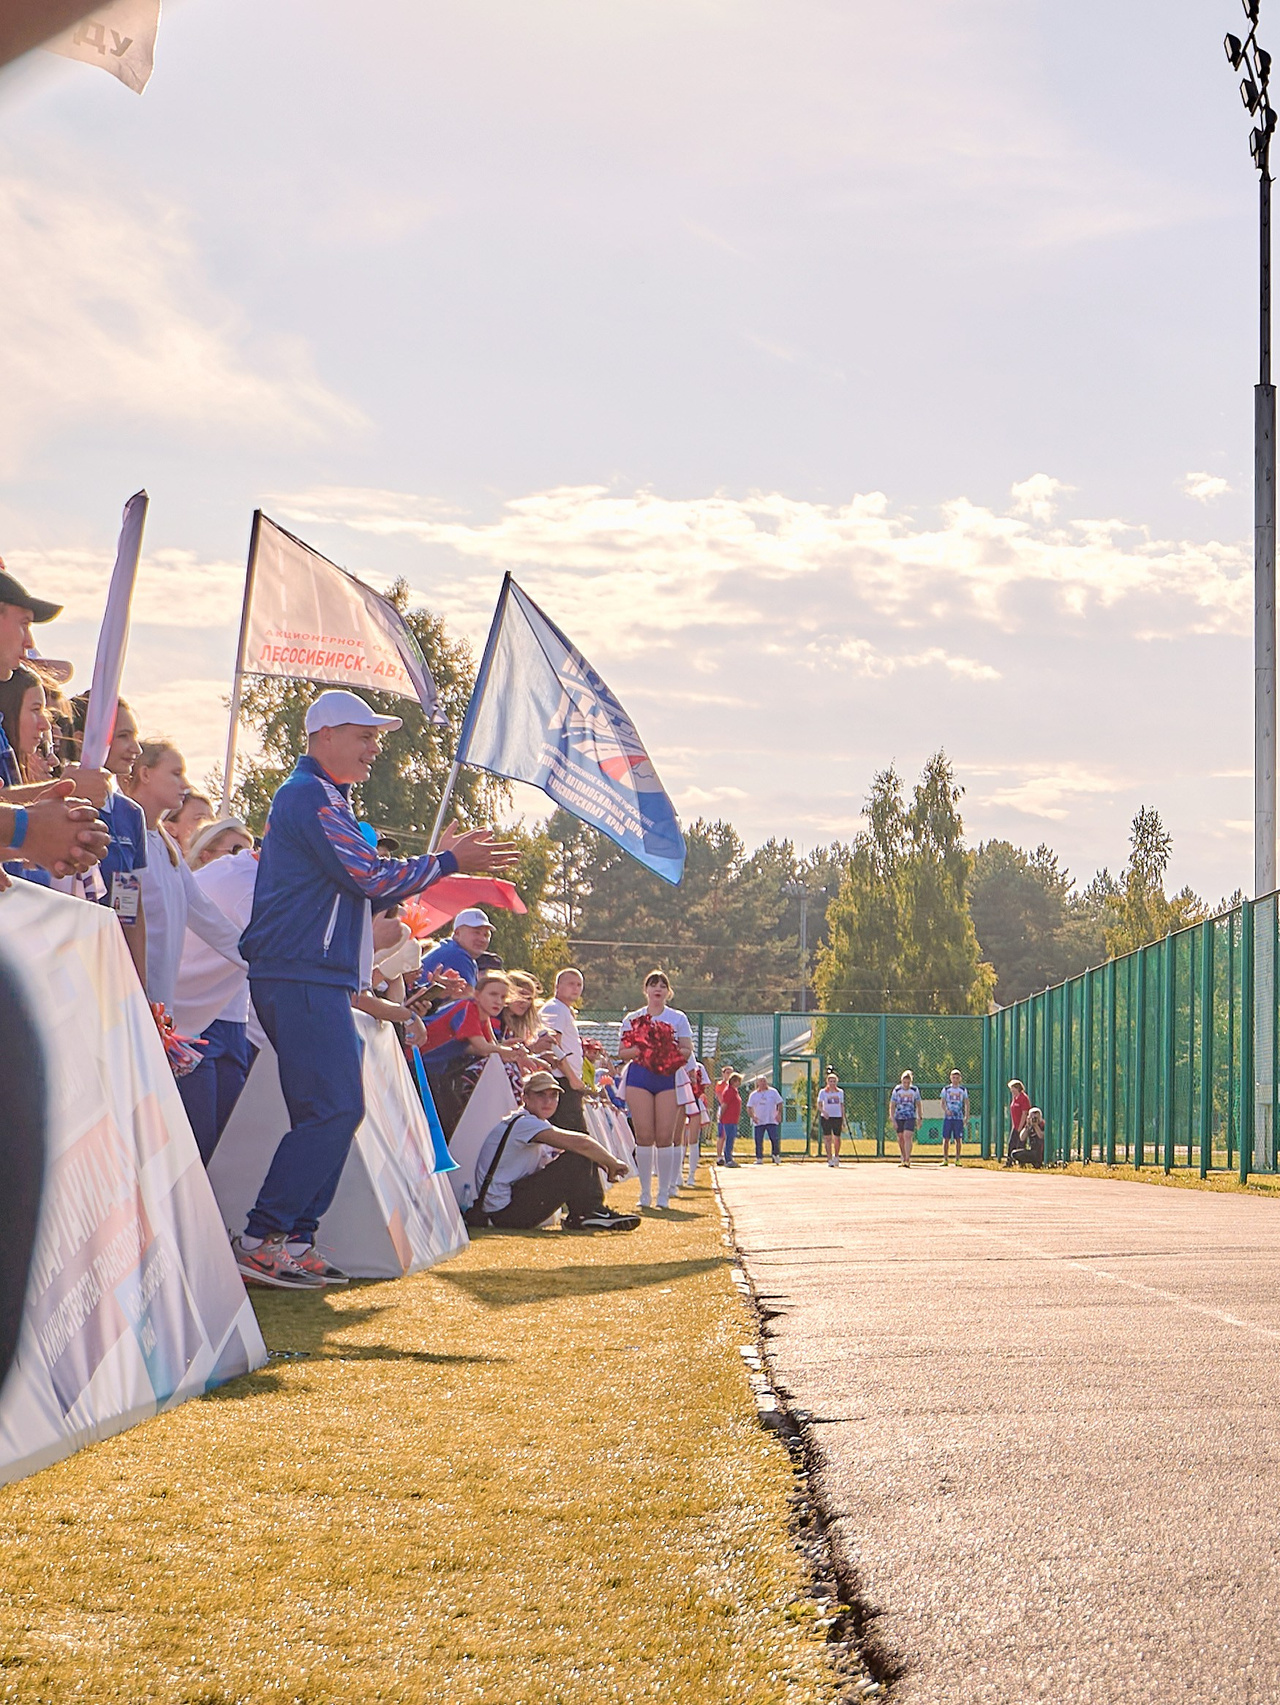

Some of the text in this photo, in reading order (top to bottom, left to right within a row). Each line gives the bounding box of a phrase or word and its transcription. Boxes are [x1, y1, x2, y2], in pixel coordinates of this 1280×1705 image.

[265, 630, 366, 648] АКЦИОНЕРНОЕ
[565, 774, 625, 821] АВТОМОБИЛЬНЫХ
[605, 814, 626, 836] КРАЮ
[40, 1265, 103, 1368] МИНИСТЕРСТВА
